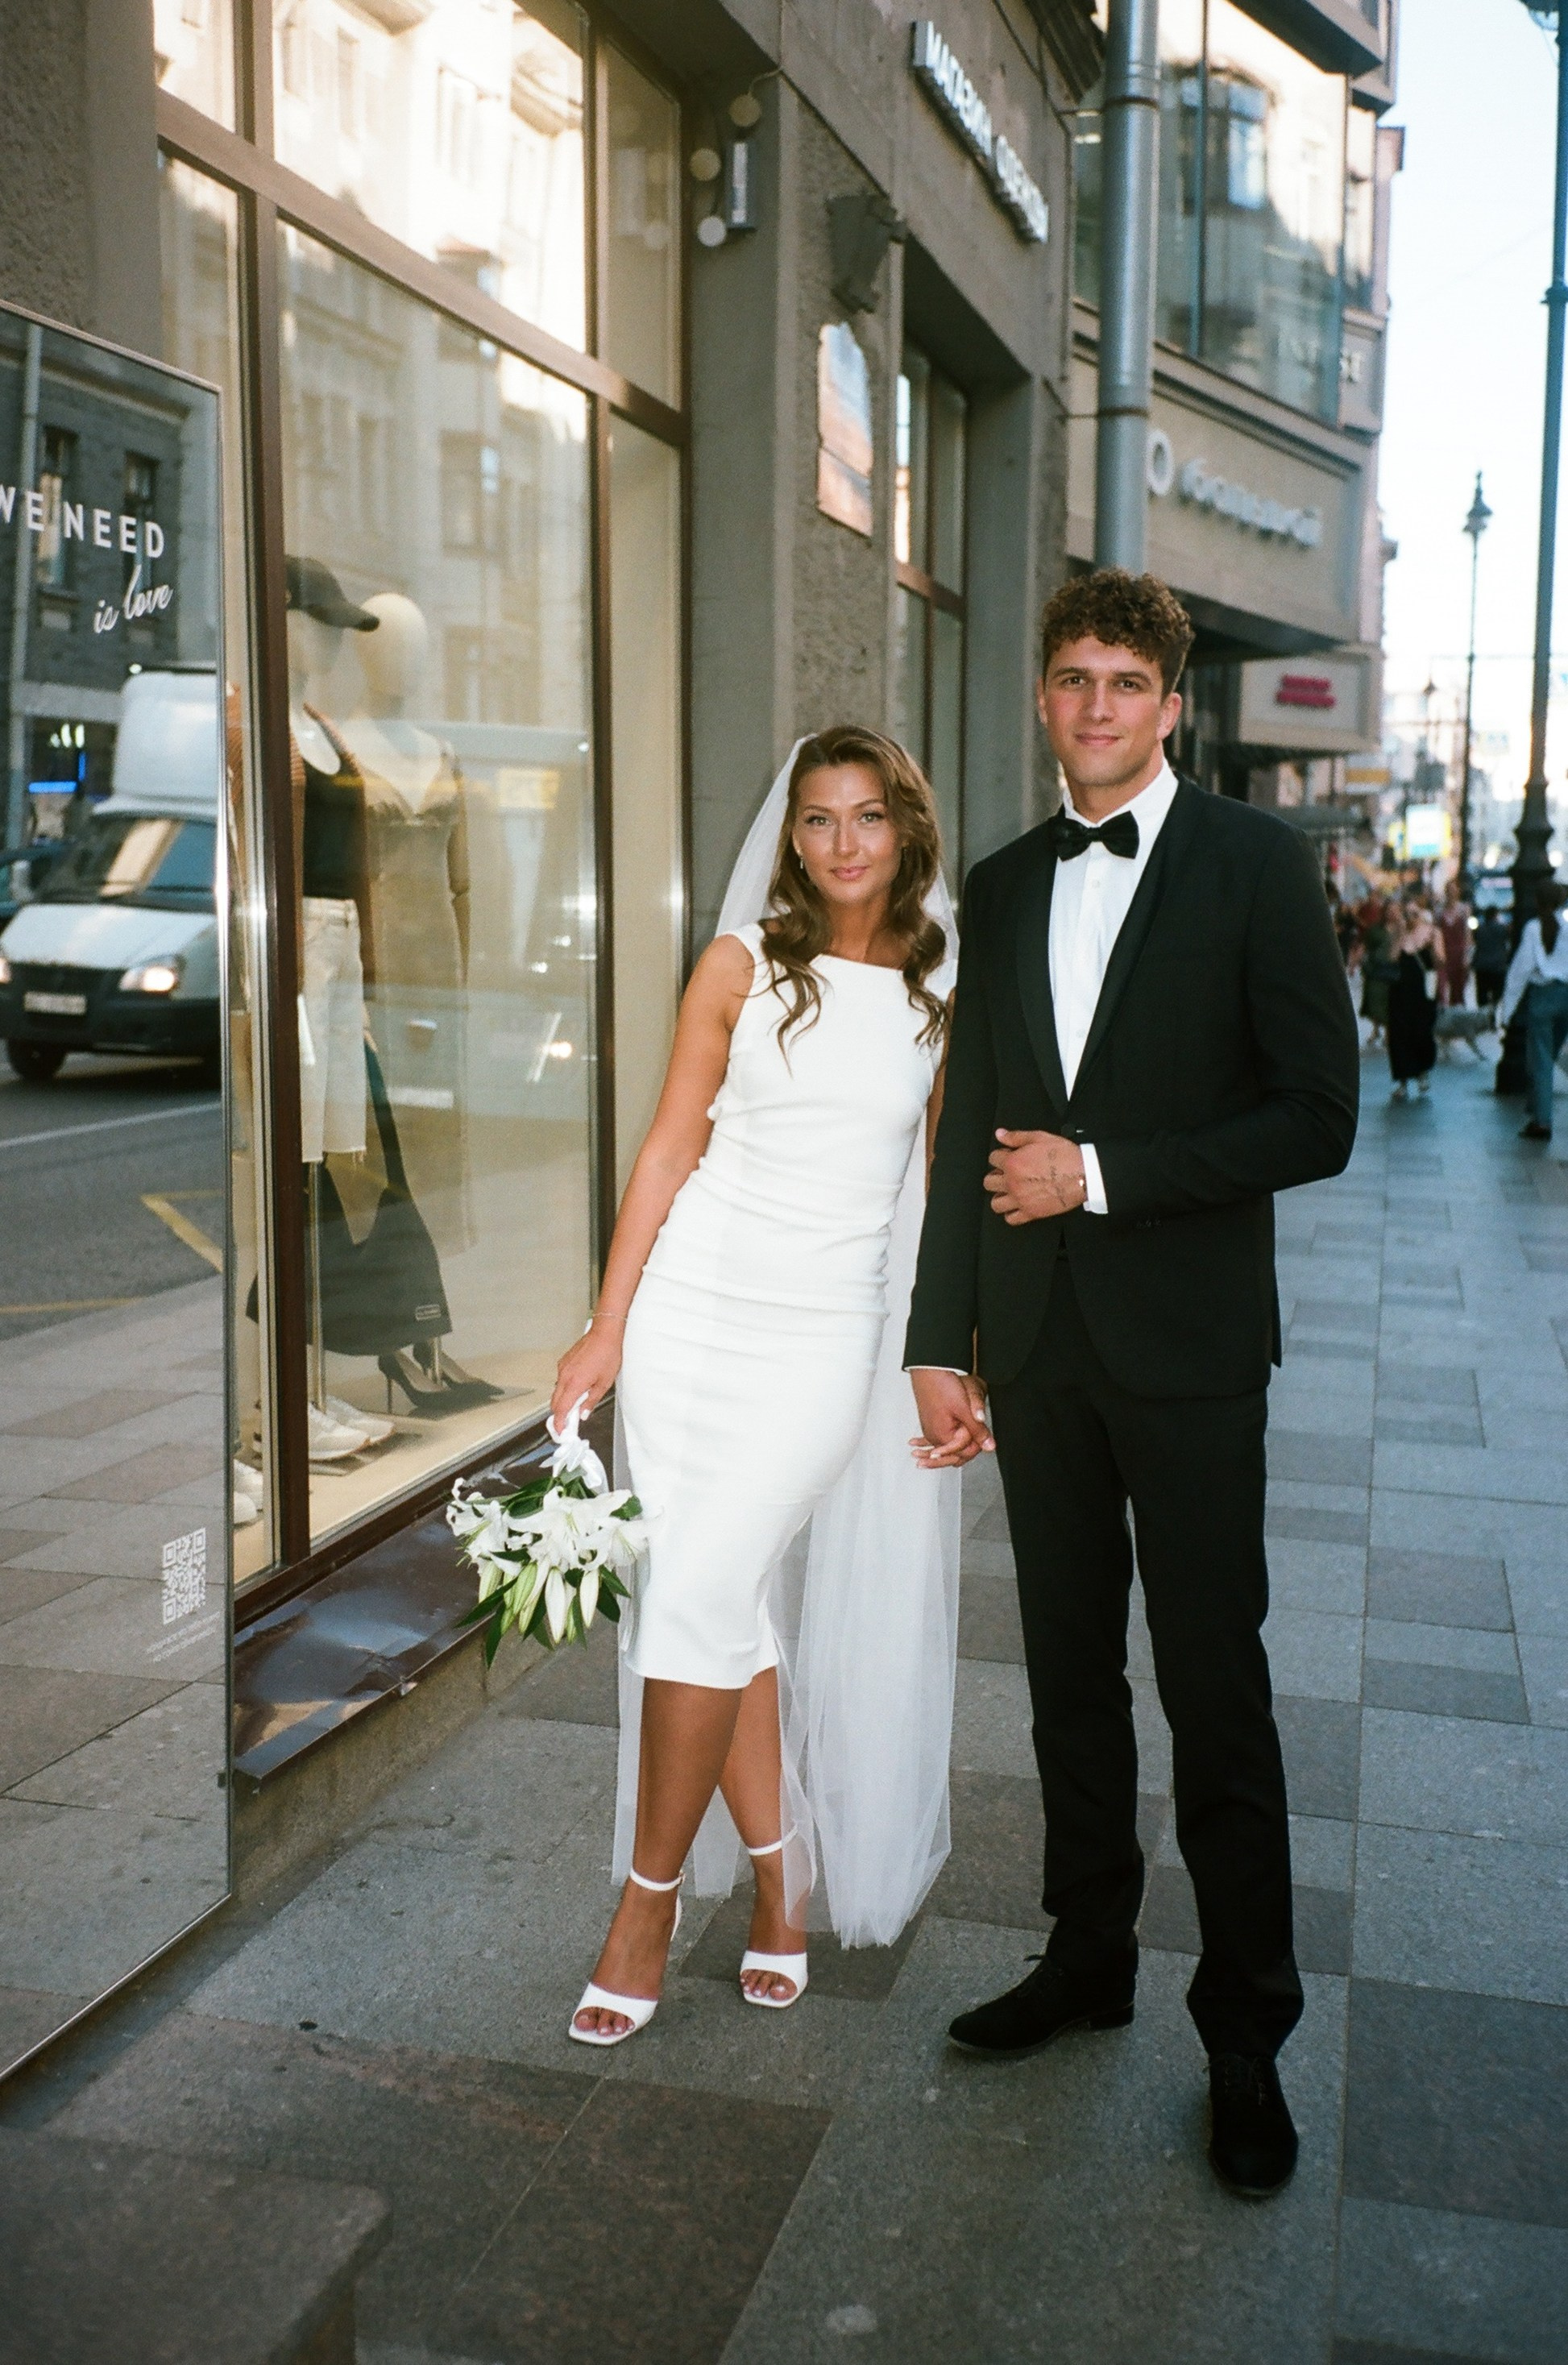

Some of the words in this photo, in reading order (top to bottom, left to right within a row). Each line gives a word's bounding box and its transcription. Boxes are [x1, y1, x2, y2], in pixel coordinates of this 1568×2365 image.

[63, 501, 164, 558] NEED
[93, 600, 120, 633] is
[123, 564, 174, 620] love
